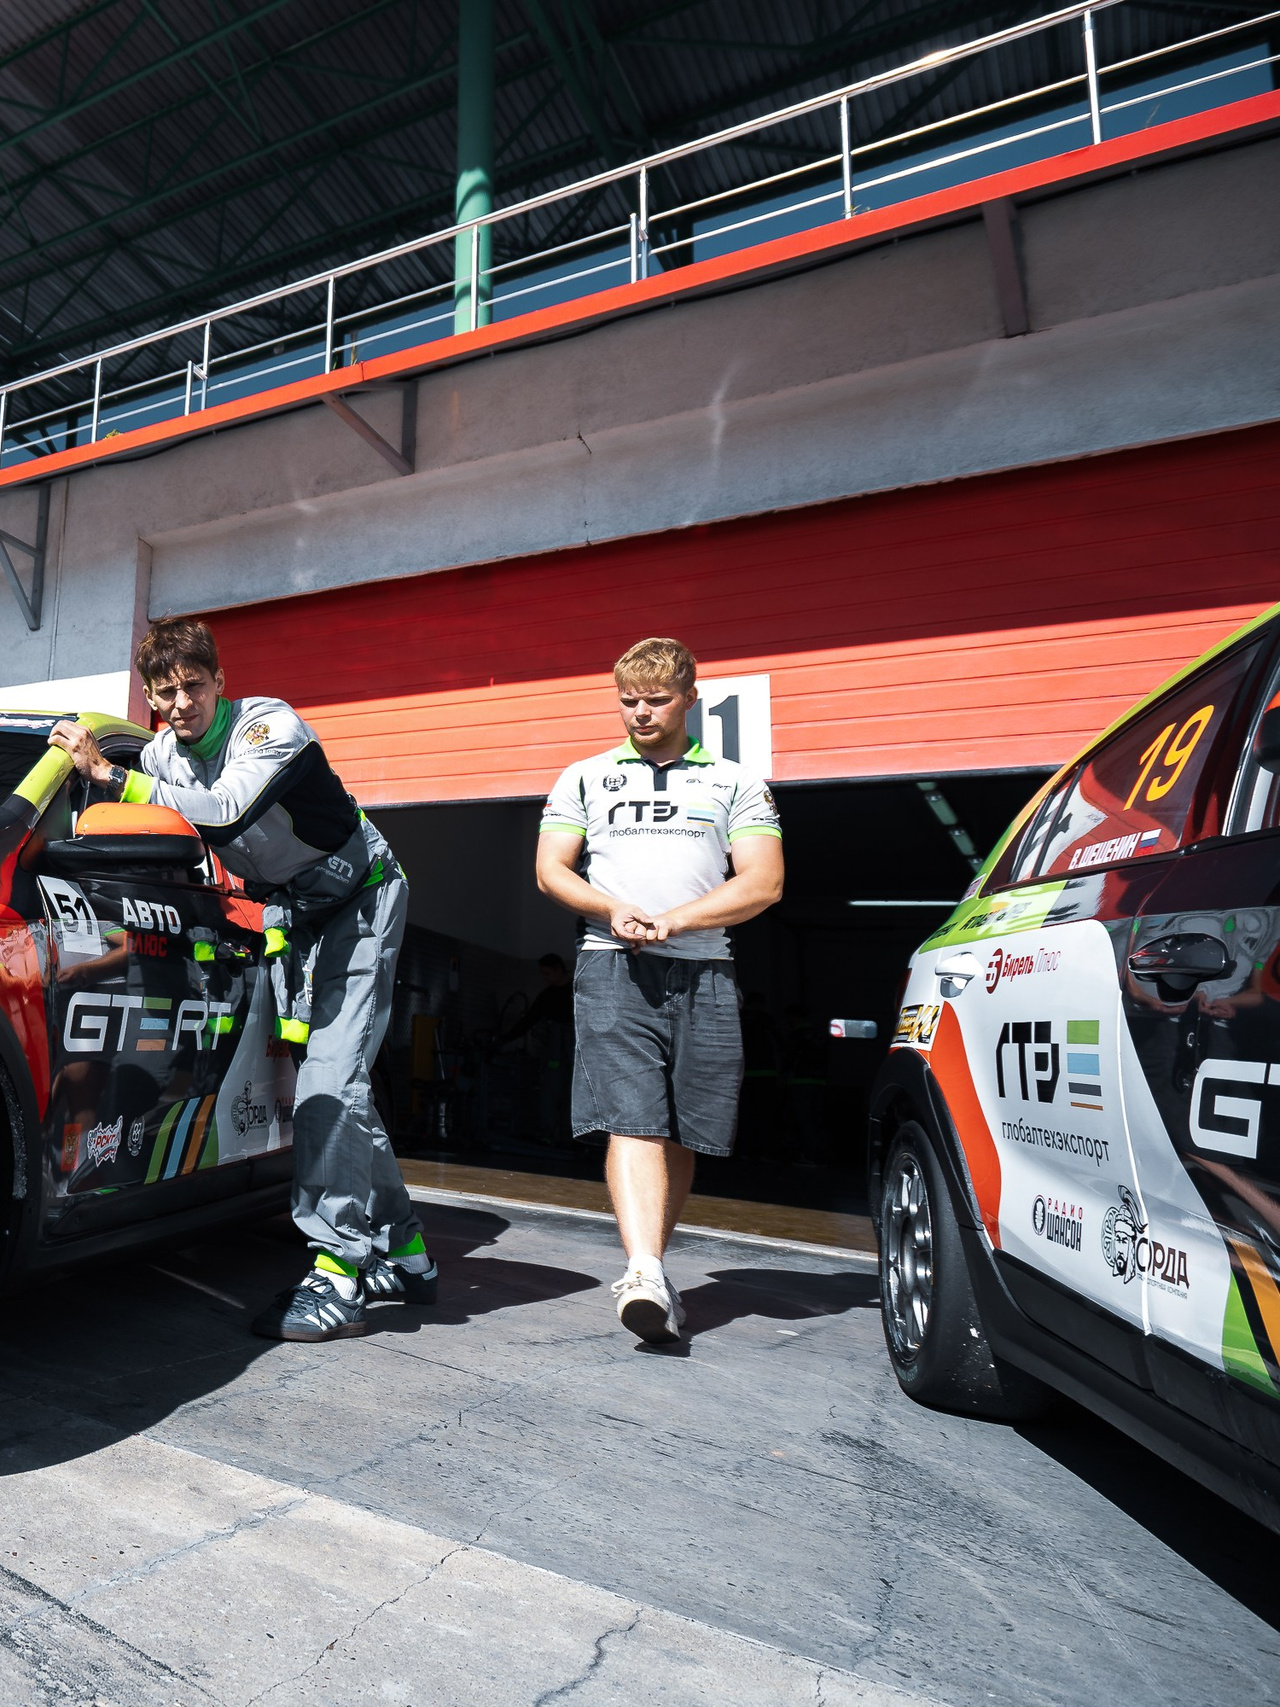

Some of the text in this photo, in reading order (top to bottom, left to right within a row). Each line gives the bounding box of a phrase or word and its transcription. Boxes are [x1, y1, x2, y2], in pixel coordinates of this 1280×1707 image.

[1123, 704, 1215, 811] 19
[609, 827, 706, 839] глобалтехэкспорт
[53, 892, 93, 935] 51
[122, 897, 181, 935] АВТО
[1001, 953, 1034, 982] Бирель
[1189, 1058, 1280, 1160] G
[1001, 1117, 1110, 1167] глобалтехэкспорт
[1048, 1197, 1083, 1220] РАДИО
[1046, 1212, 1082, 1252] ШАНСОН
[1136, 1237, 1190, 1290] ОРДА
